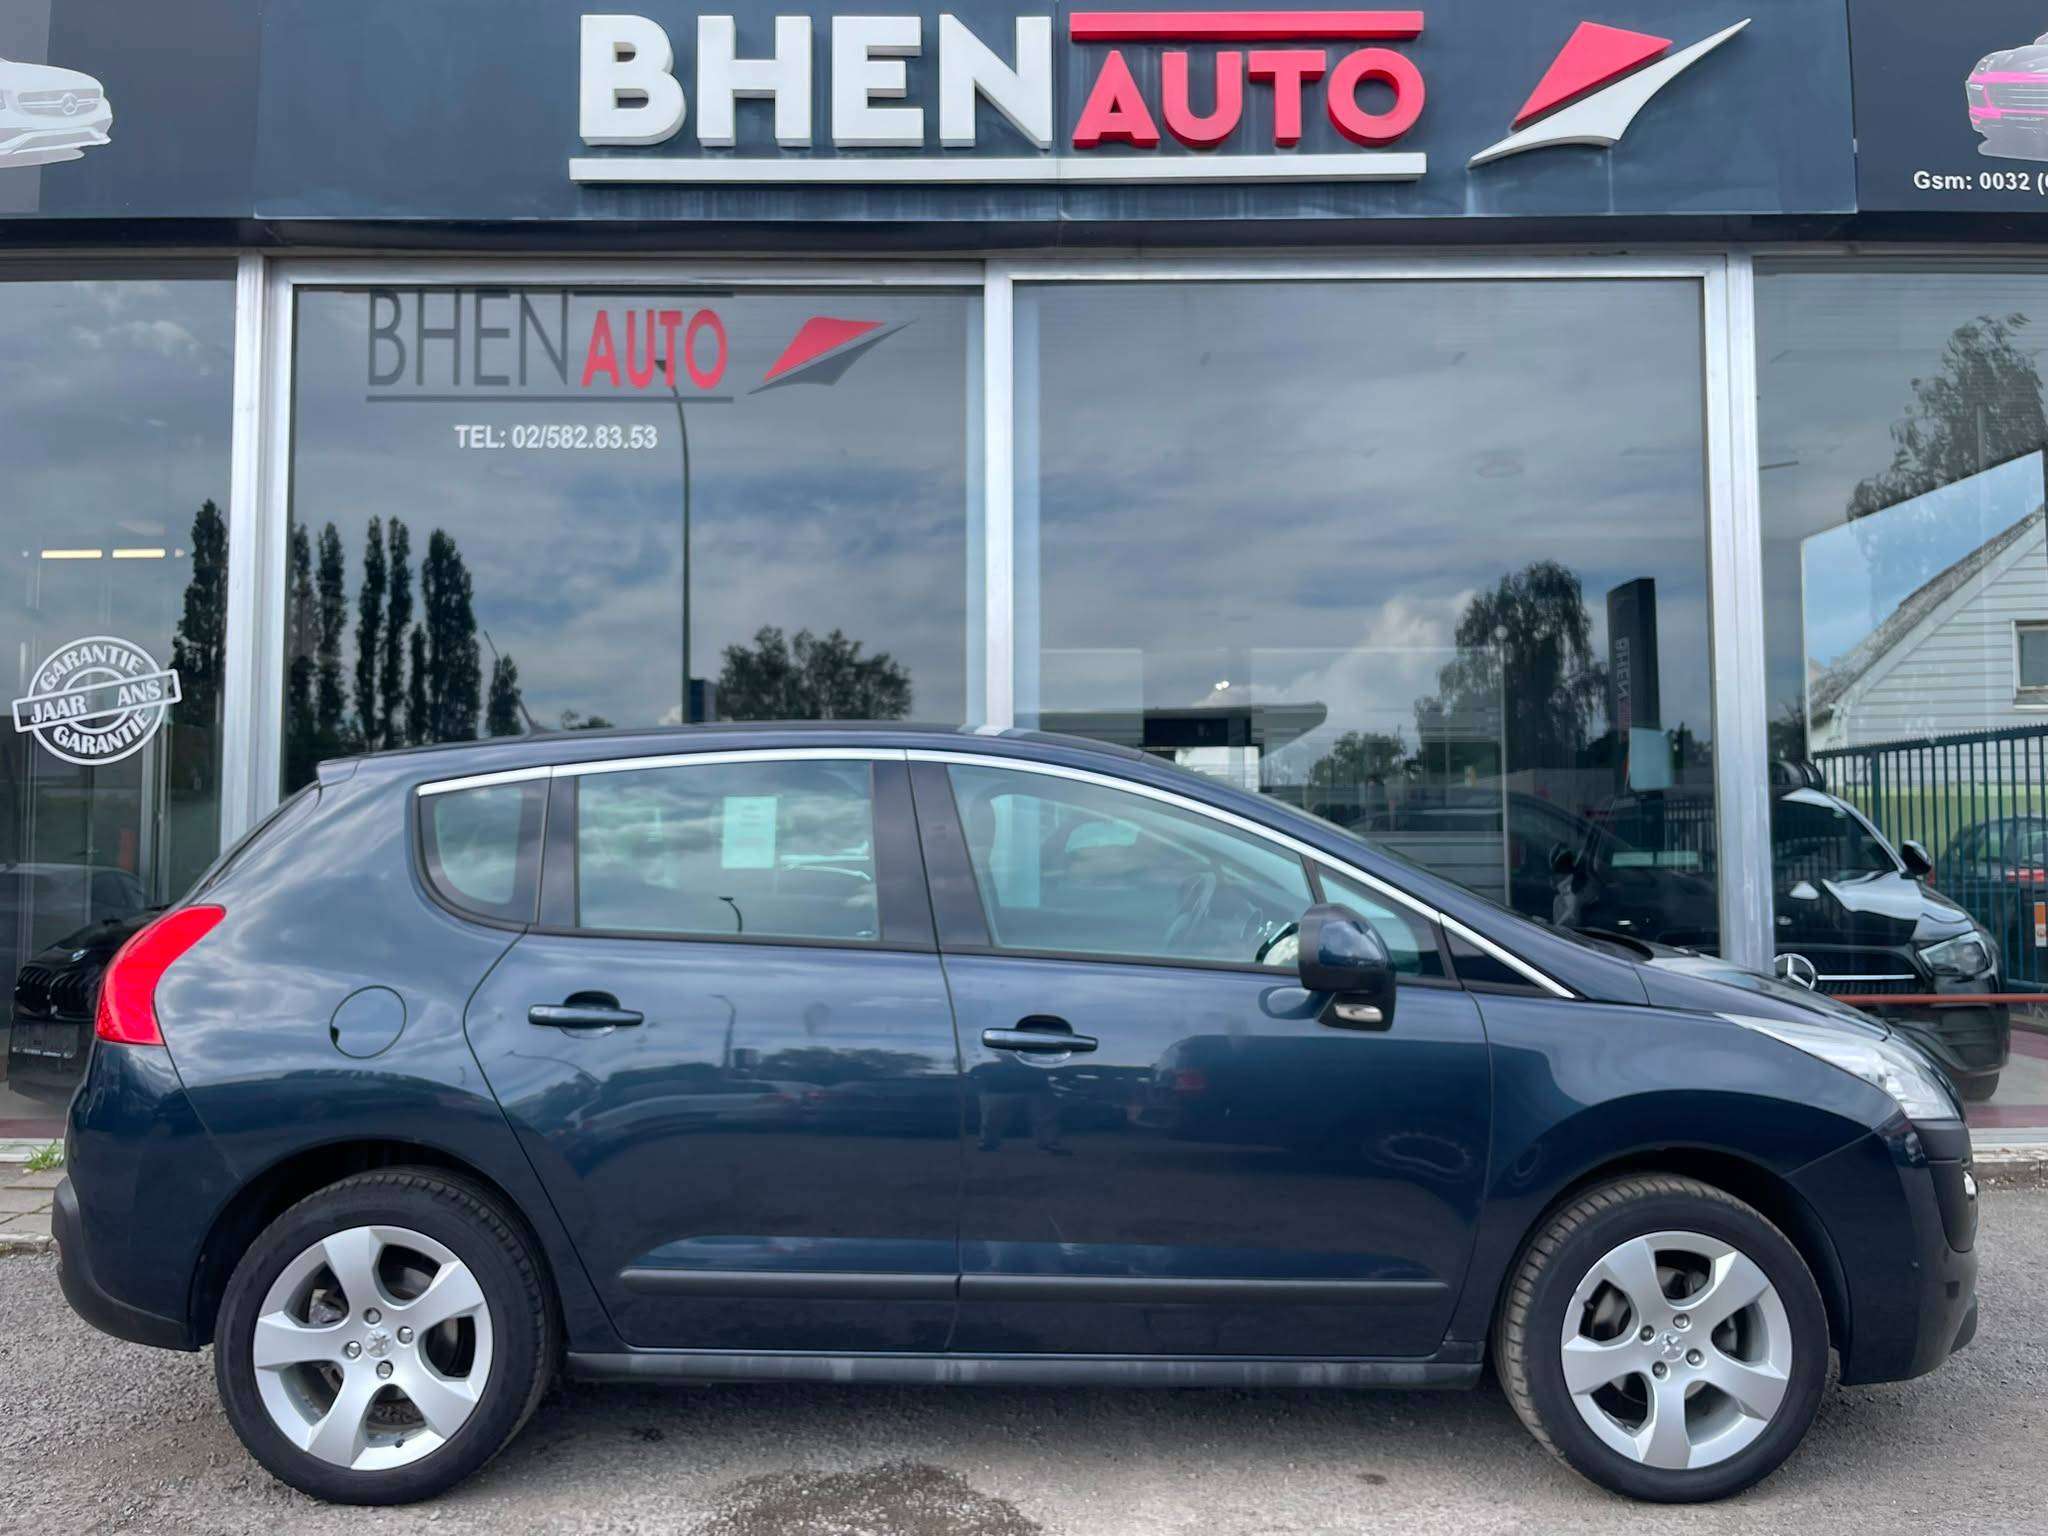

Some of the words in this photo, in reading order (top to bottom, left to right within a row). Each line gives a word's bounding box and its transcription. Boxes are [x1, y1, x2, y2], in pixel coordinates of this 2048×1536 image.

[579, 13, 1054, 150] BHEN
[1070, 46, 1426, 149] AUTO
[1913, 170, 1973, 191] Gsm:
[1979, 172, 2032, 191] 0032
[367, 288, 568, 387] BHEN
[580, 308, 729, 390] AUTO
[454, 424, 506, 450] TEL:
[511, 424, 658, 450] 02/582.83.53
[39, 644, 145, 692] GARANTIE
[31, 694, 88, 724] JAAR
[117, 679, 162, 708] ANS
[52, 709, 152, 755] GARANTIE
